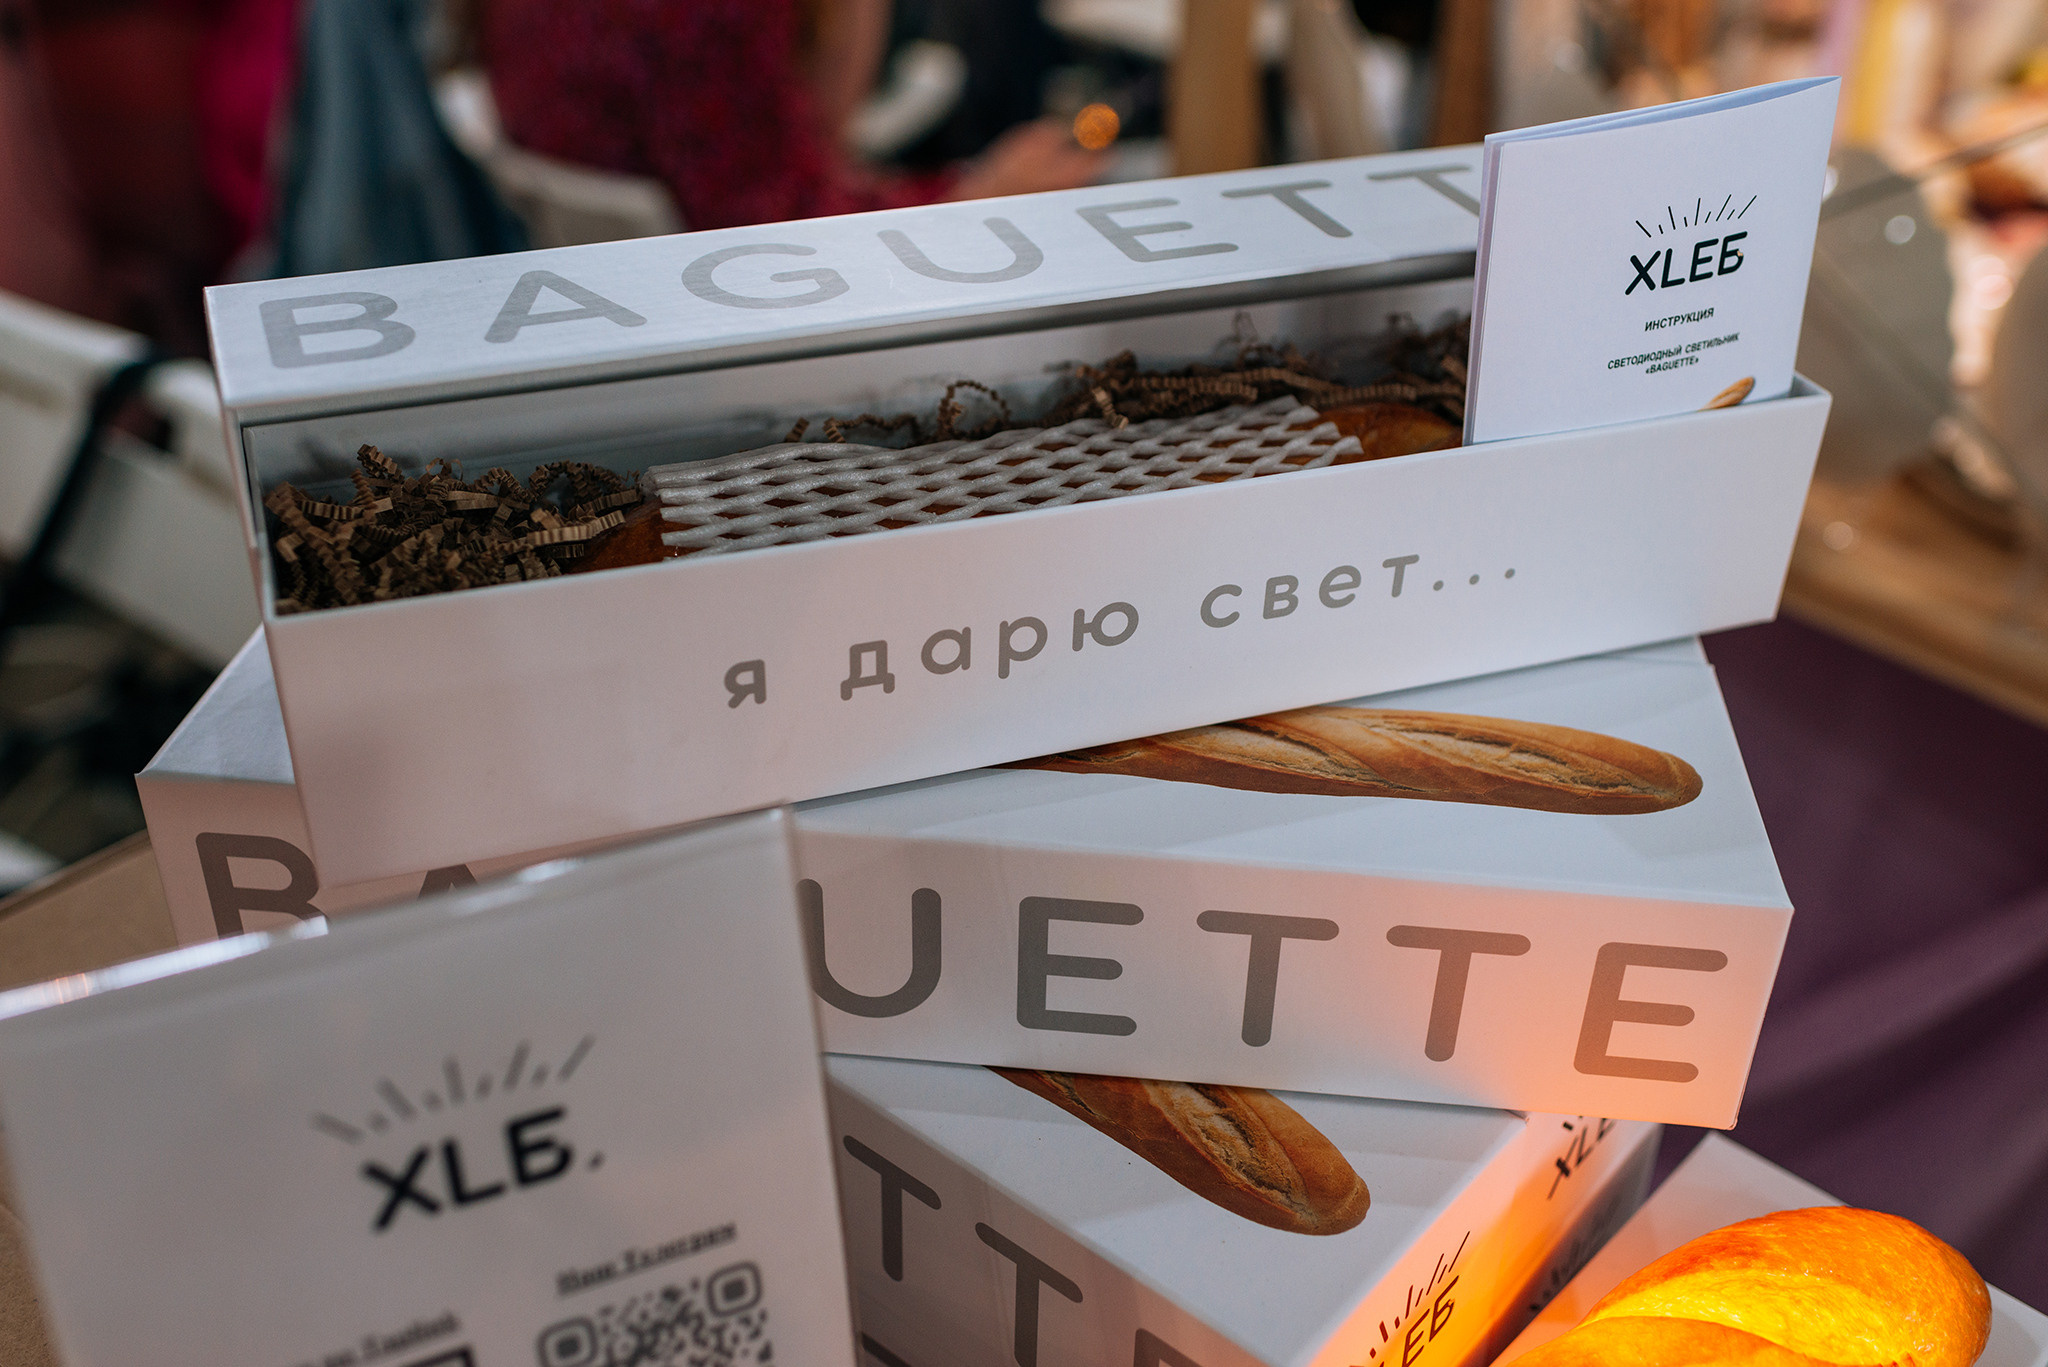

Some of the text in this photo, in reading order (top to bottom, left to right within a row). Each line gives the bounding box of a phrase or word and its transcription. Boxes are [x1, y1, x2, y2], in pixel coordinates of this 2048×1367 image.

[259, 164, 1481, 368] BAGUETT
[1607, 332, 1740, 370] СВЕТОДИОДНЫЙ СВЕТИЛЬНИК
[1644, 307, 1714, 332] ИНСТРУКЦИЯ
[1645, 356, 1699, 374] «BAGUETTE»
[724, 554, 1517, 708] я дарю свет...
[195, 832, 1730, 1084] BUETTE
